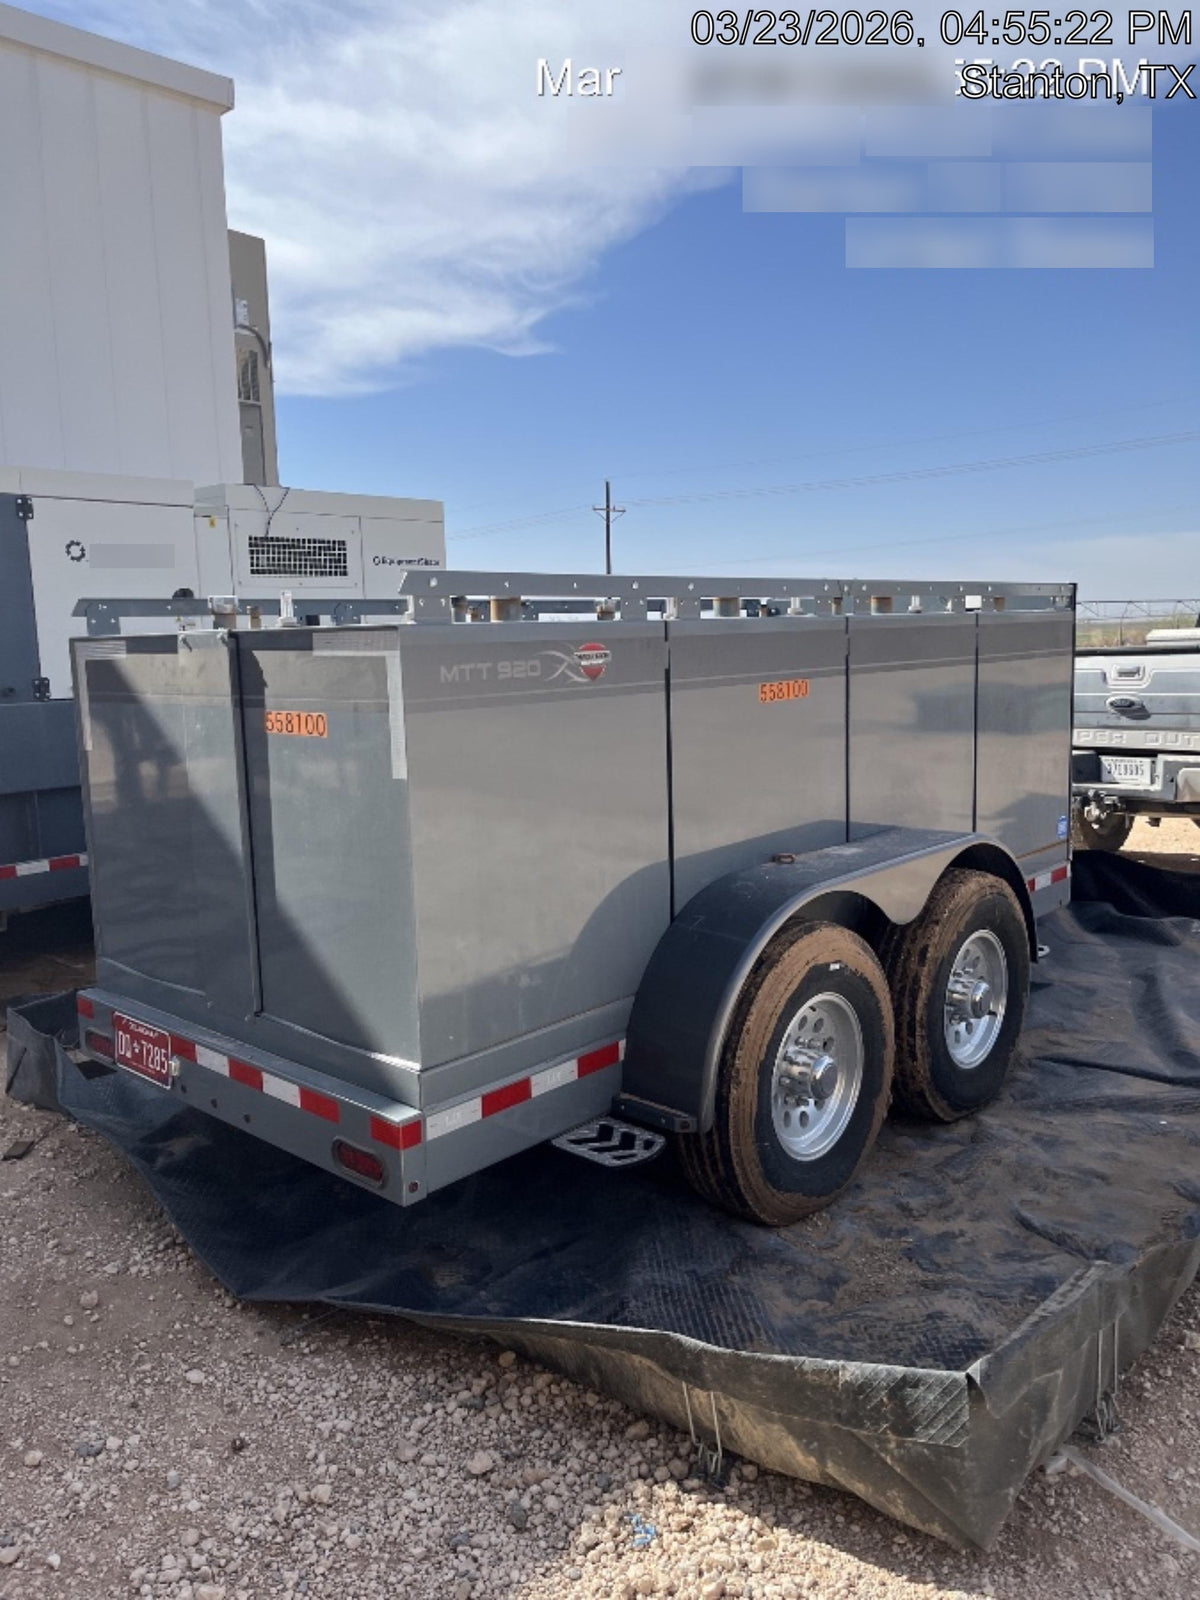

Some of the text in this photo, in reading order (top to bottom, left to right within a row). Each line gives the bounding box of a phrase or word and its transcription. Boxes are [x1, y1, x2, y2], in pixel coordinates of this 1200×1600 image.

[440, 659, 541, 684] MTT 920
[760, 679, 808, 703] 558100
[265, 710, 326, 737] 558100
